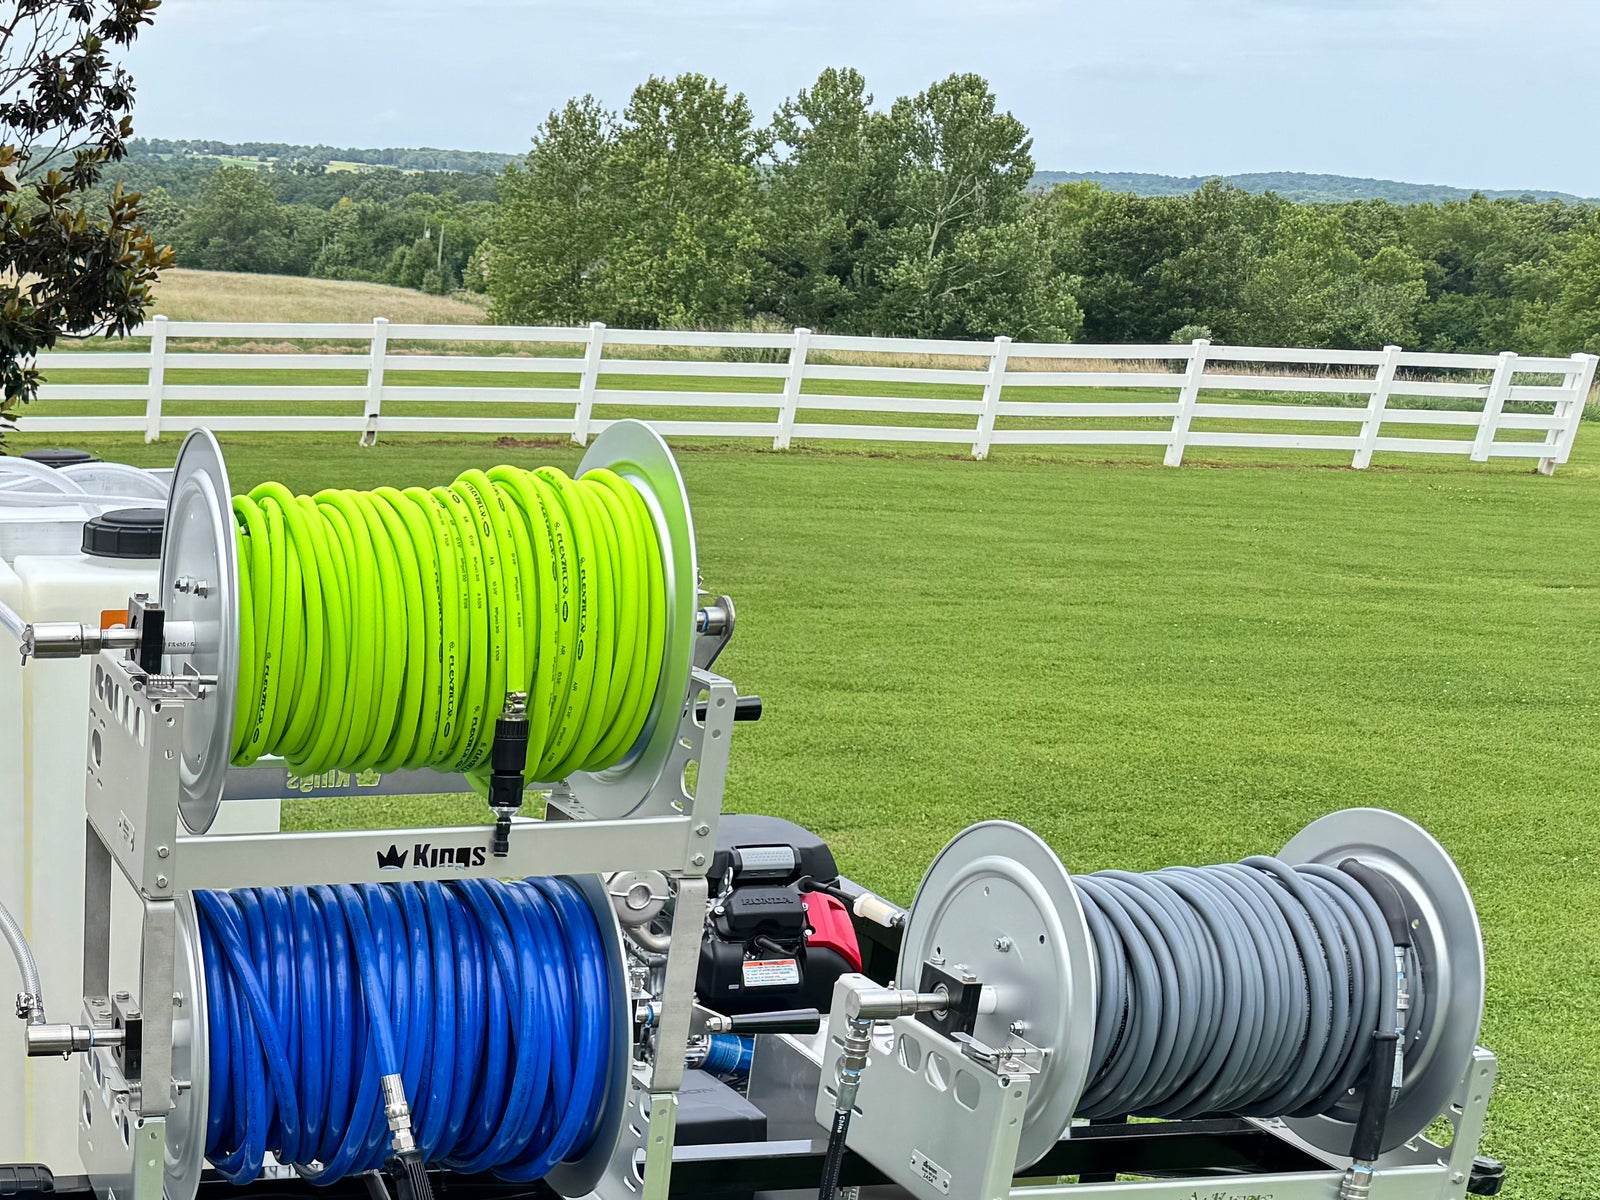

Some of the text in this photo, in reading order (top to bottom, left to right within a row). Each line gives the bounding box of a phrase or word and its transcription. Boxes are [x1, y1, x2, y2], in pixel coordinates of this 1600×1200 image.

[556, 532, 569, 595] FLEXZILLA
[579, 569, 587, 633] FLEXZILLA
[257, 665, 270, 724] FLEXZILLA
[447, 655, 455, 718] FLEXZILLA
[413, 843, 487, 870] Kings
[741, 897, 794, 906] HONDA
